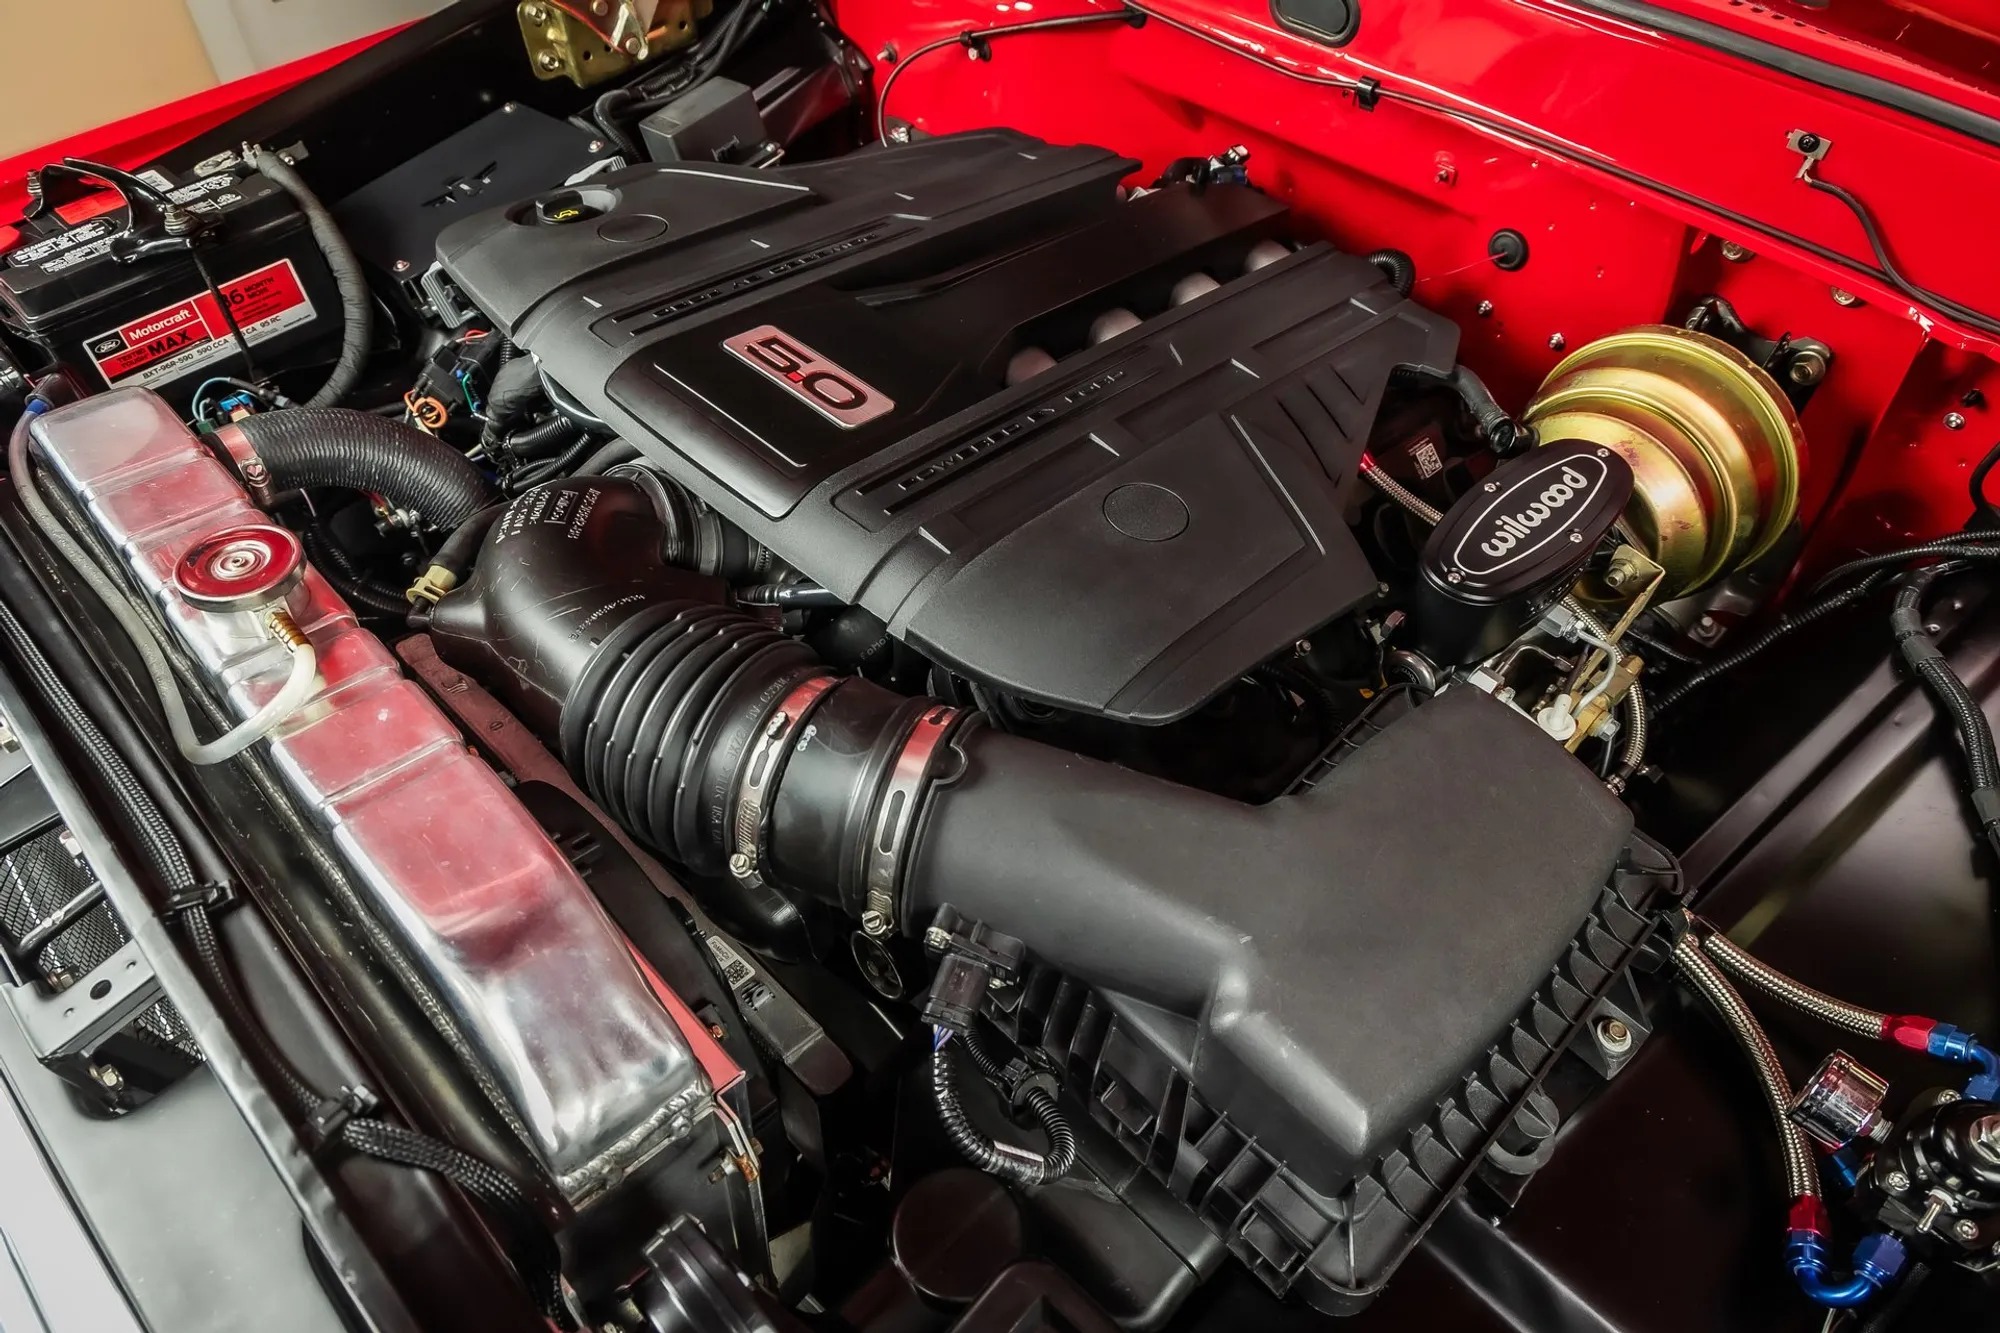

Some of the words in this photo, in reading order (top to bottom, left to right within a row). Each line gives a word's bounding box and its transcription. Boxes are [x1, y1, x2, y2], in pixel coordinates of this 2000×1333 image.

[129, 309, 191, 341] Motorcraft
[147, 330, 192, 357] MAX
[142, 353, 194, 380] BXT-96R-590
[196, 345, 213, 356] 590
[212, 338, 229, 348] CCA
[744, 335, 868, 410] 5.0
[1481, 466, 1588, 557] wilwood
